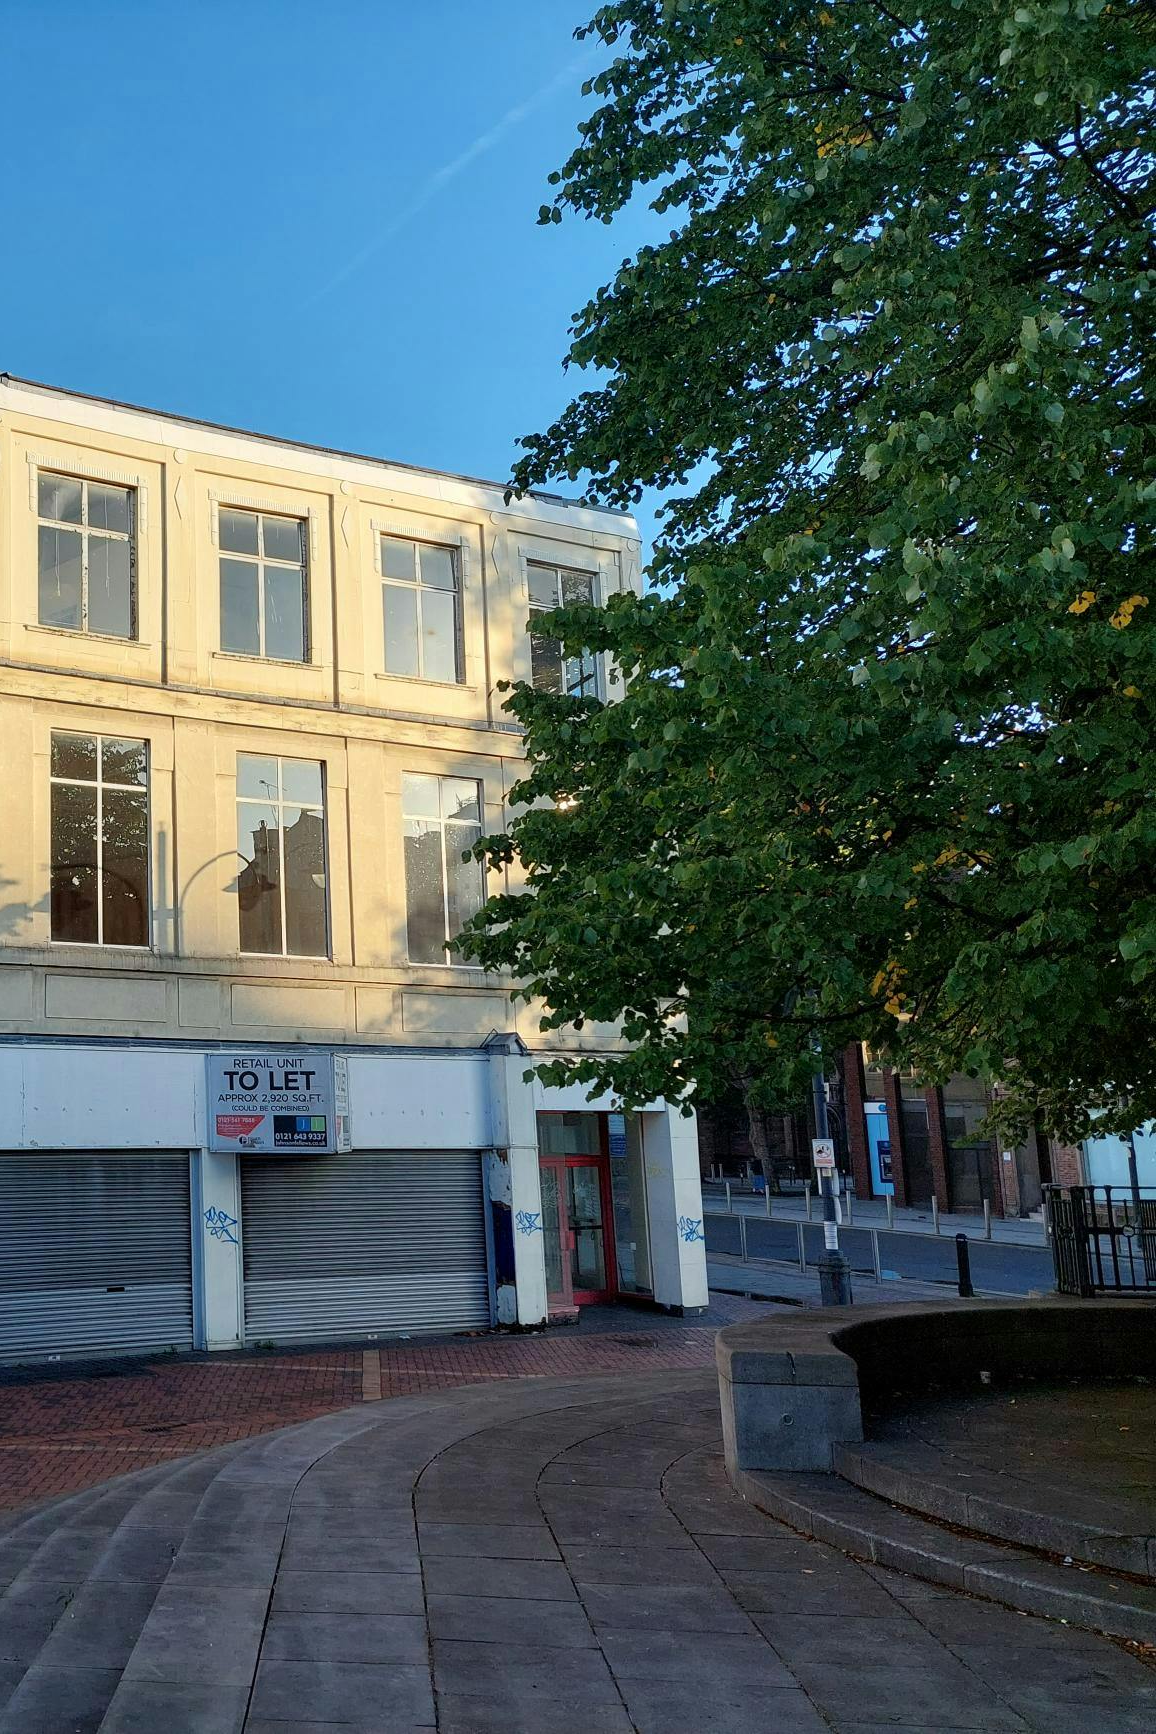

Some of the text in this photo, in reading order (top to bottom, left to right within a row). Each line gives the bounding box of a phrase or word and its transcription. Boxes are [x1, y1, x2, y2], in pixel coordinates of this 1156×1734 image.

[233, 1058, 305, 1068] RETAIL UNIT
[223, 1071, 316, 1091] TO LET
[218, 1093, 258, 1103] APPROX
[262, 1093, 289, 1104] 2,920
[275, 1132, 325, 1140] 0121 643 9337
